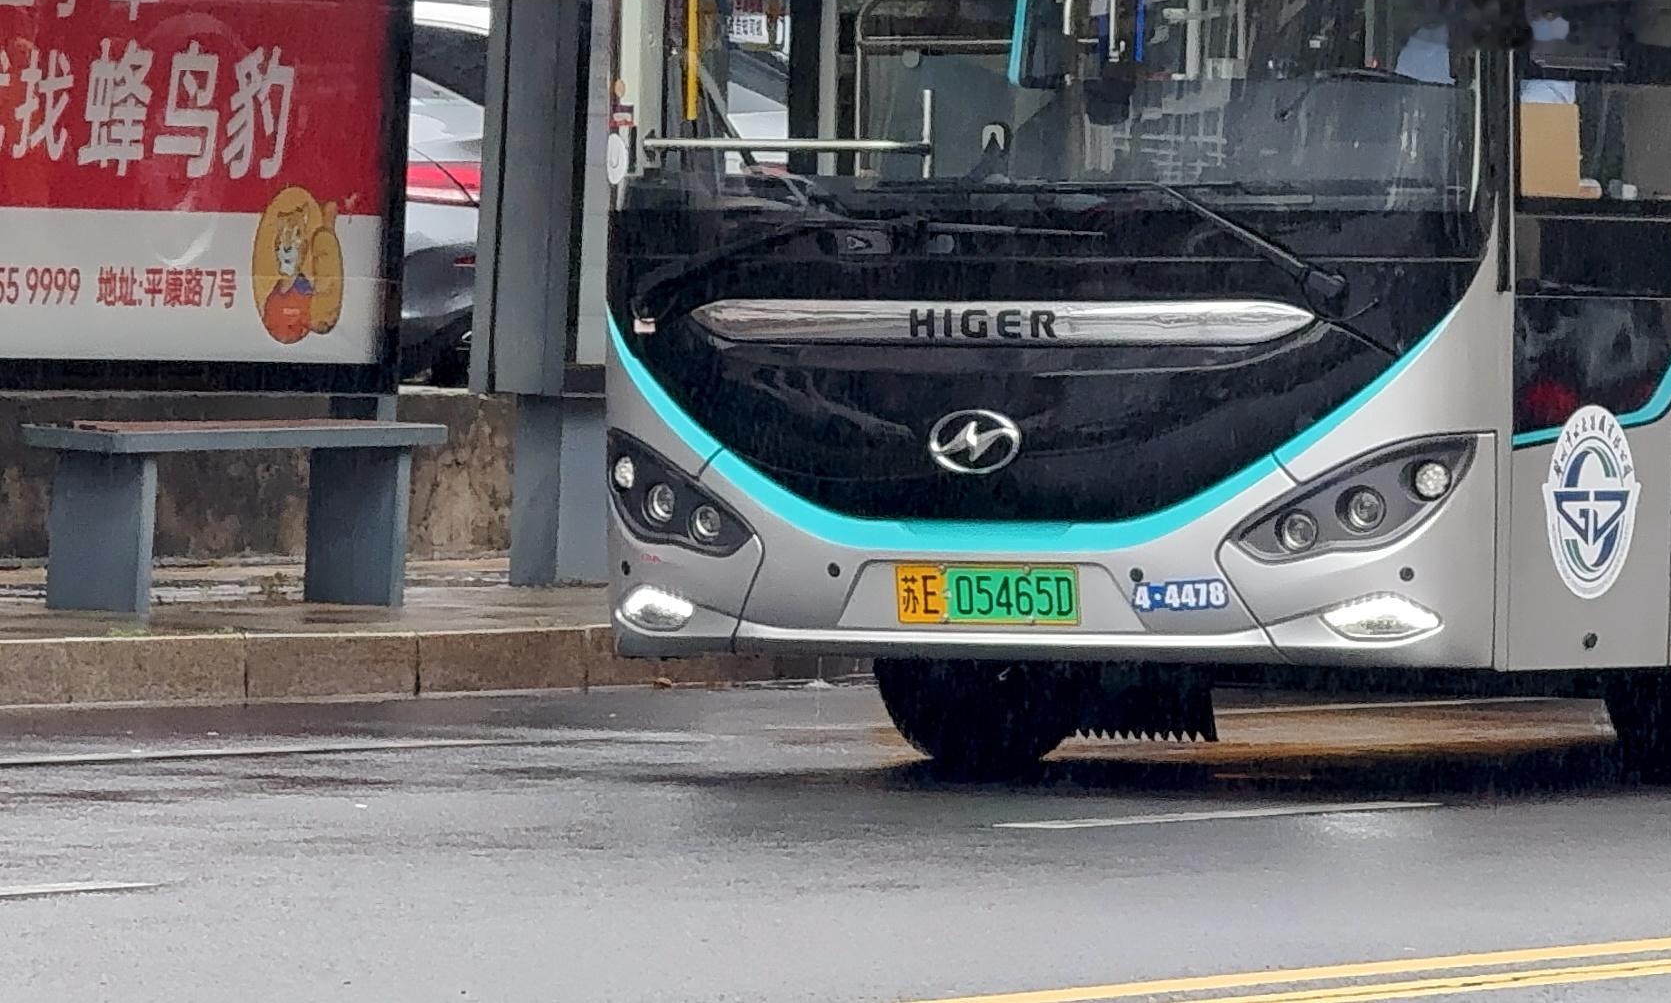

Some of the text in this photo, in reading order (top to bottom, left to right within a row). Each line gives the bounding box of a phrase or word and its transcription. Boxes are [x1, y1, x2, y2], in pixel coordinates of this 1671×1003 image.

[0, 38, 295, 180] 找蜂鸟豹
[26, 266, 80, 305] 9999
[909, 308, 1057, 339] HIGER
[955, 575, 1074, 616] 05465D
